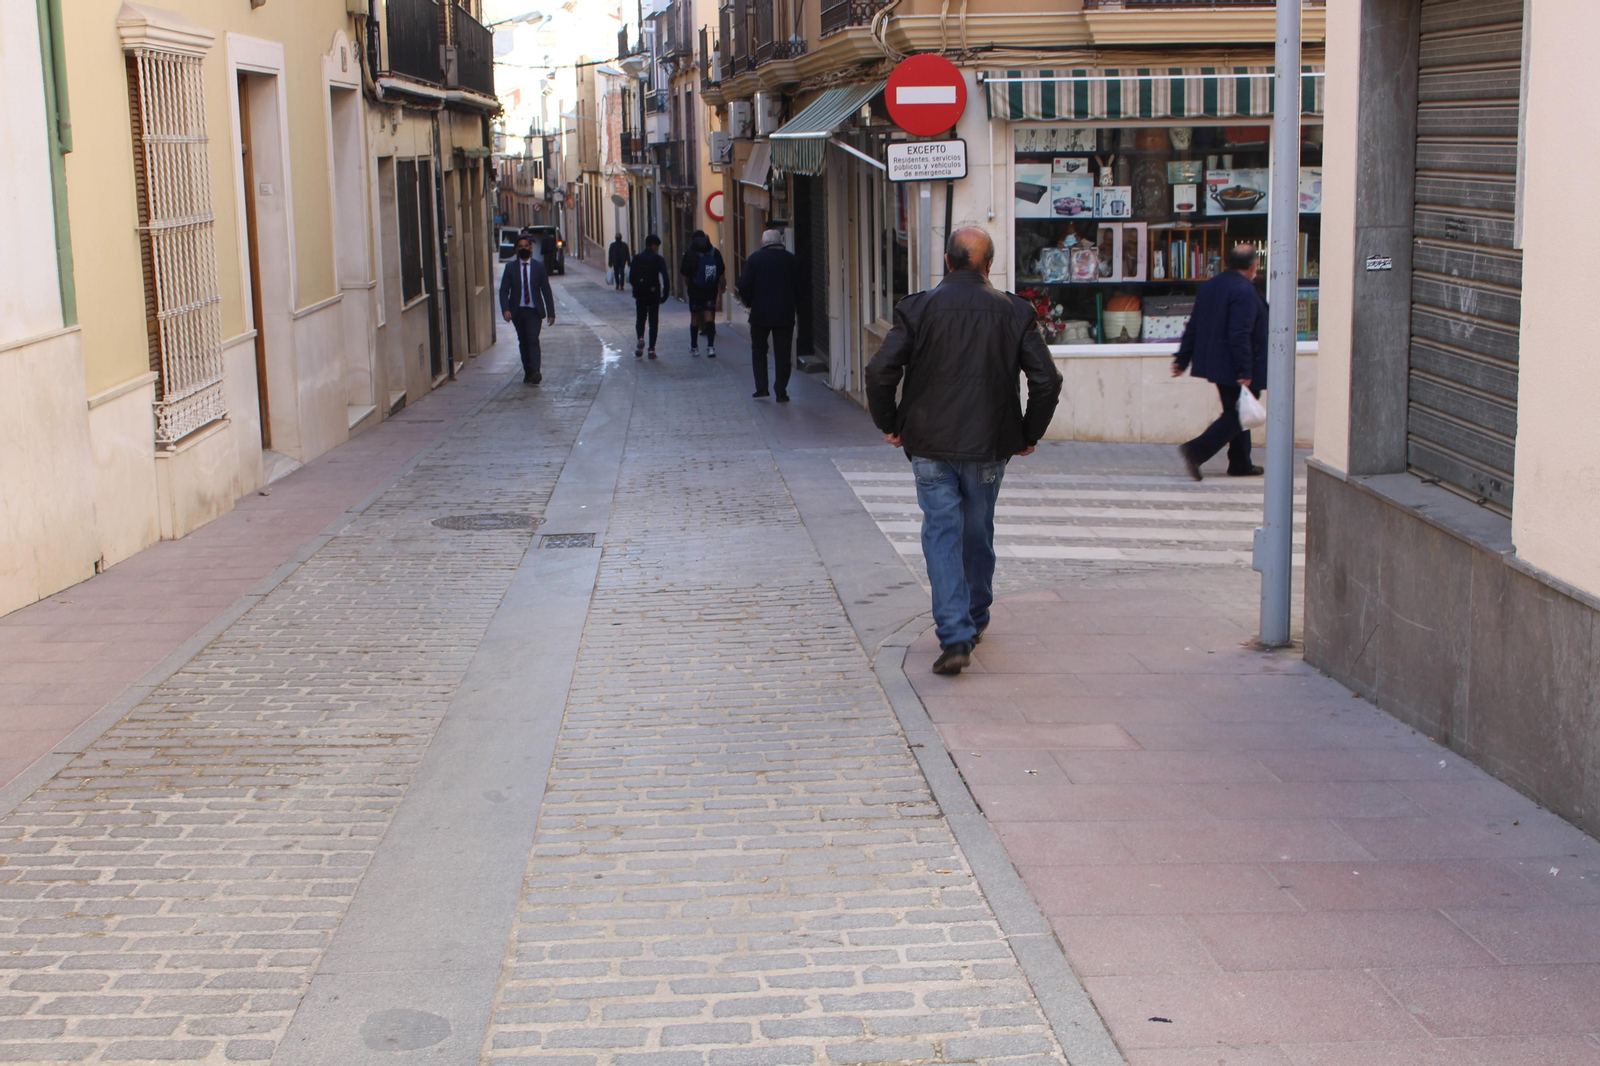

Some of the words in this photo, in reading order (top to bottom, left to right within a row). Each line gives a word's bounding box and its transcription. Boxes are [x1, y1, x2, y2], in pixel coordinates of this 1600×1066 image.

[907, 145, 947, 155] EXCEPTO
[932, 154, 961, 162] servicios
[894, 163, 922, 172] públicos
[930, 161, 962, 169] vehículos
[914, 169, 952, 177] emergencia
